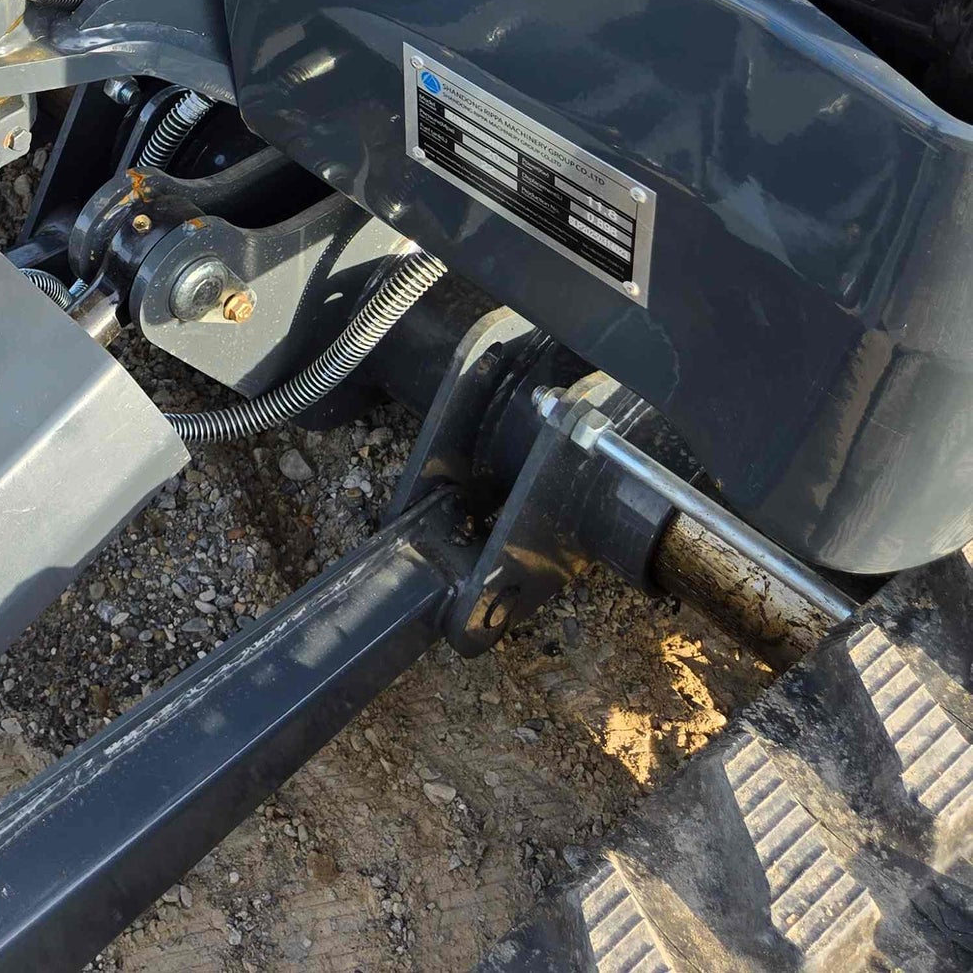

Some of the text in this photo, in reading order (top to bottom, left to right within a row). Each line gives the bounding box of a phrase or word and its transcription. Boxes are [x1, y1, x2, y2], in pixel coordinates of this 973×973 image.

[442, 82, 483, 113] SHANDONG
[483, 107, 503, 125] RIPPA
[504, 119, 547, 152] MACHINERY
[547, 146, 574, 168] GROUP
[586, 194, 618, 223] 11.8
